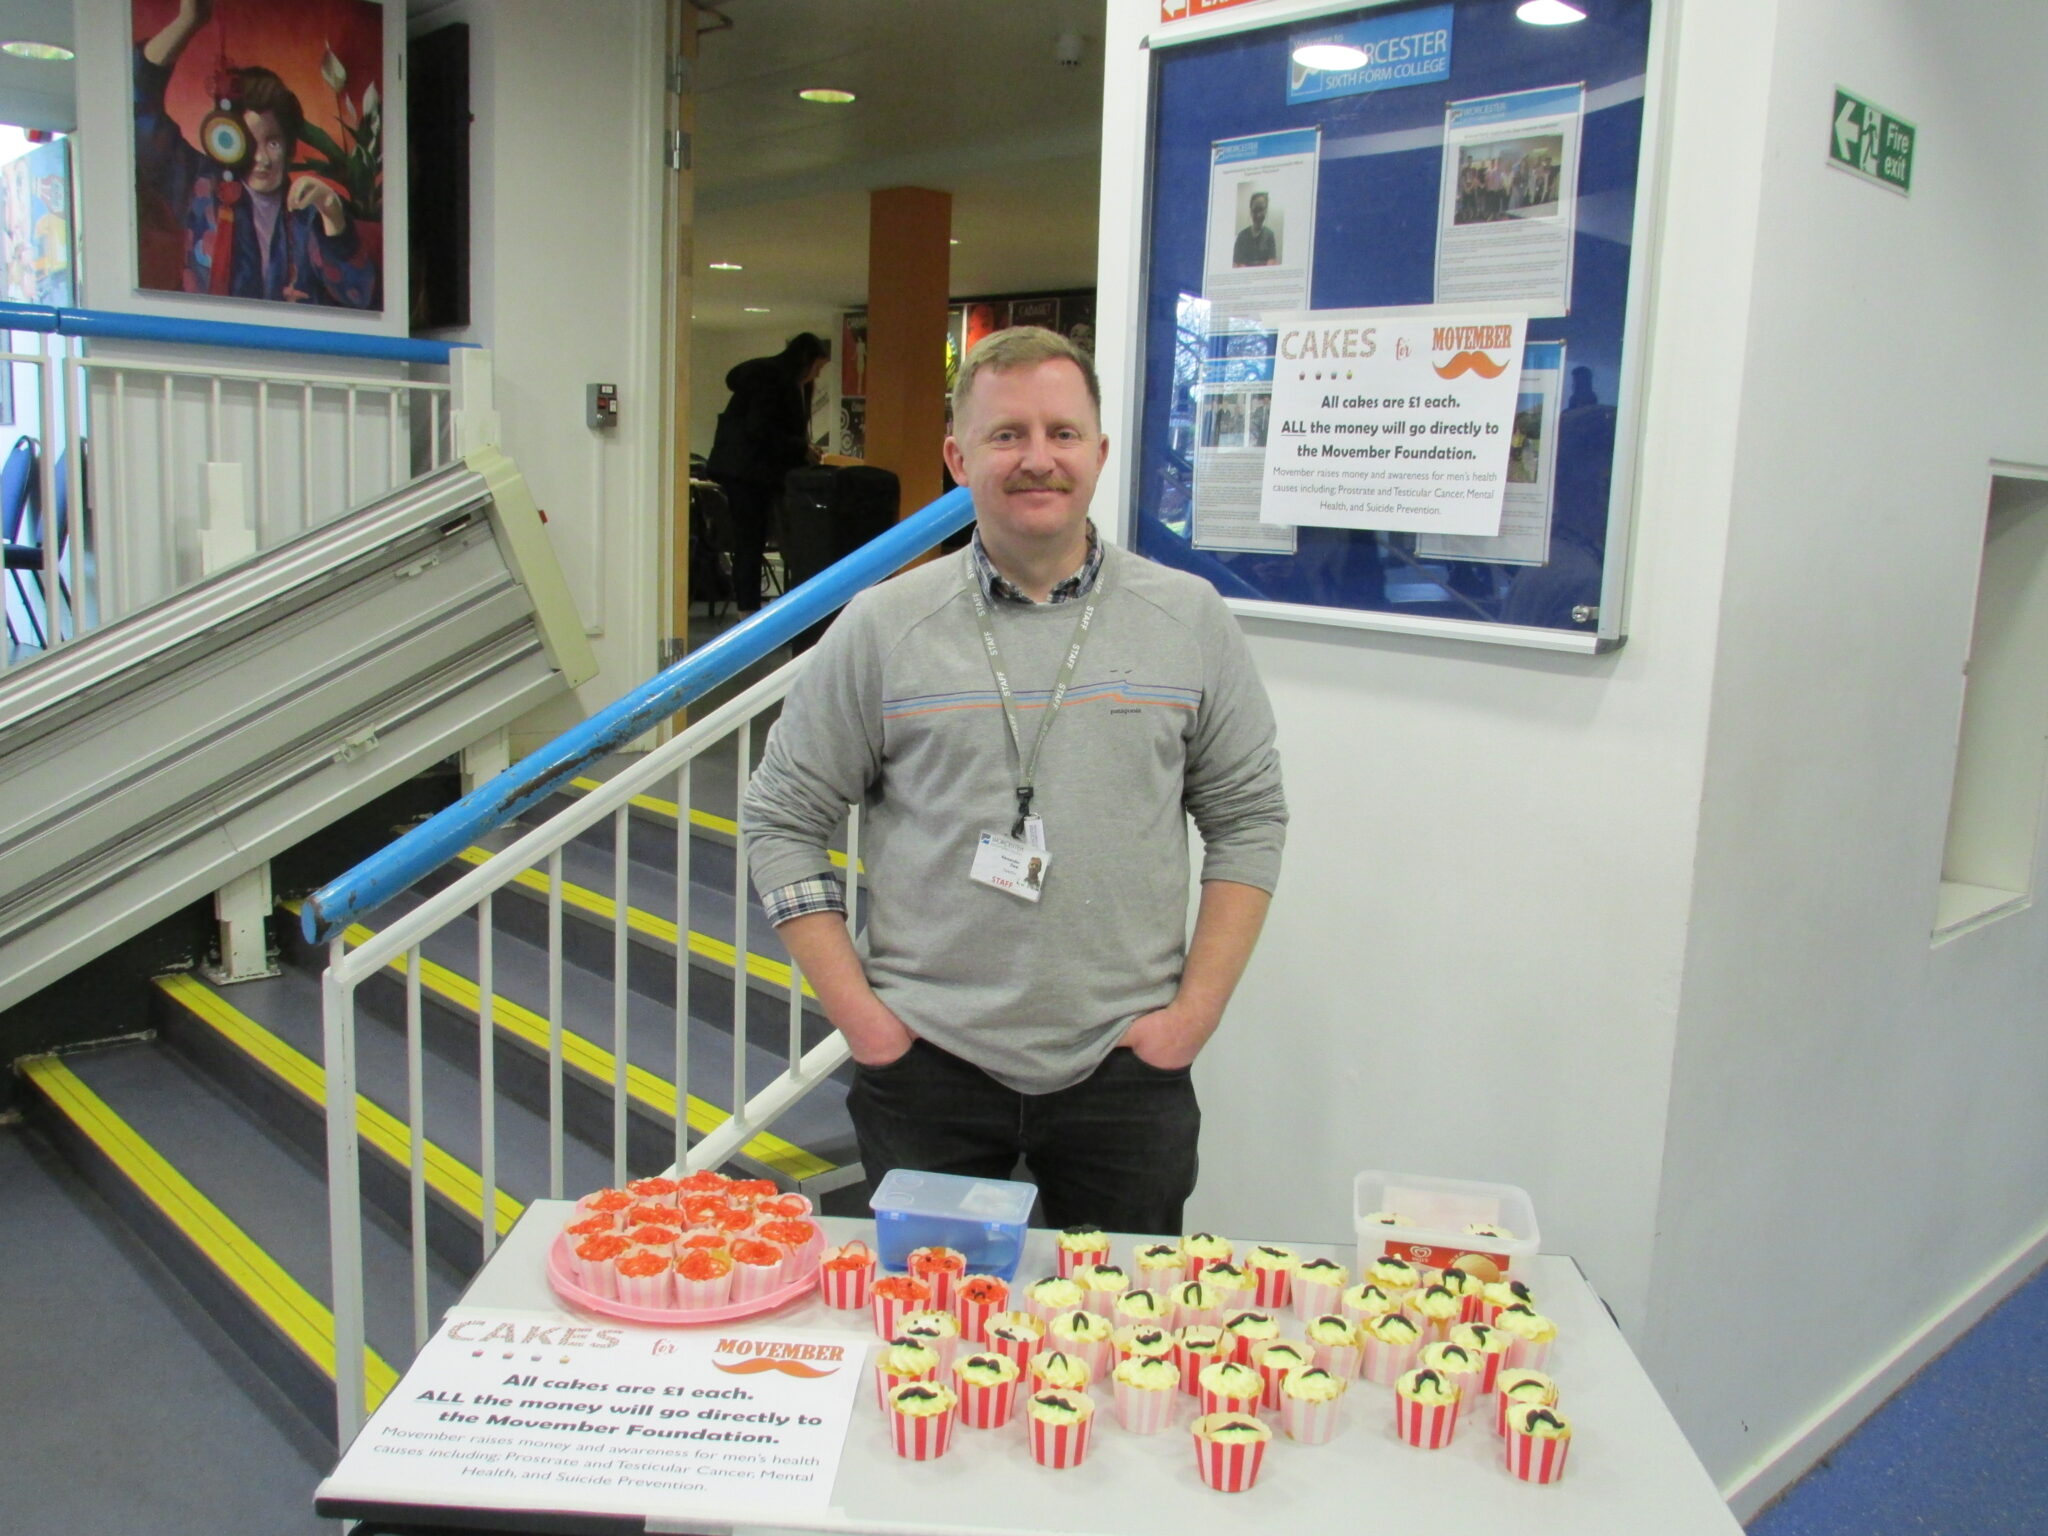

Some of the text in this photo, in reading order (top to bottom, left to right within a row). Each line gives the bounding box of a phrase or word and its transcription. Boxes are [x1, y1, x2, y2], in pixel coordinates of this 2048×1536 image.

[1363, 29, 1447, 64] RCESTER
[1326, 57, 1446, 90] SIXTH FORM COLLEGE
[1886, 121, 1910, 154] Fire
[1884, 153, 1906, 181] exit
[1280, 324, 1512, 361] CAKES for MOVEMBER
[1321, 394, 1461, 408] All cakes are £1 each.
[1281, 420, 1499, 437] ALL the money will go directly to
[1297, 445, 1476, 460] the Movember Foundation.
[1273, 466, 1314, 478] Movember
[1317, 468, 1339, 478] raises
[1342, 470, 1368, 481] money
[1371, 470, 1386, 480] and
[1388, 471, 1429, 481] awareness
[1432, 470, 1443, 481] for
[1472, 471, 1497, 482] health
[1273, 484, 1298, 493] causes
[1338, 484, 1376, 497] Prostrate
[1378, 486, 1392, 496] and
[1393, 486, 1432, 498] Testicular
[1466, 488, 1494, 499] Mental
[1320, 500, 1442, 516] Health, and Suicide Prevention.
[972, 591, 986, 617] STAFF
[1080, 605, 1095, 631] STAFF
[984, 631, 999, 656] STAFF
[1066, 643, 1081, 670] STAFF
[996, 671, 1011, 697] STAFF
[1053, 682, 1066, 710] STAFF
[991, 875, 1014, 888] STAFF
[447, 1319, 845, 1361] CAKES for MOVEMBER
[502, 1374, 754, 1400] All cakes are £1 each.
[416, 1390, 823, 1426] ALL the money will go directly to
[438, 1411, 780, 1444] the Movember Foundation.
[381, 1426, 821, 1467] Movember raises money and awareness for men's health
[373, 1443, 424, 1457] causes
[505, 1451, 579, 1468] Prostrate
[583, 1459, 613, 1469] and
[618, 1460, 689, 1474] Testicular
[760, 1470, 815, 1483] Mental
[461, 1465, 708, 1492] Health, and Suicide Prevention.
